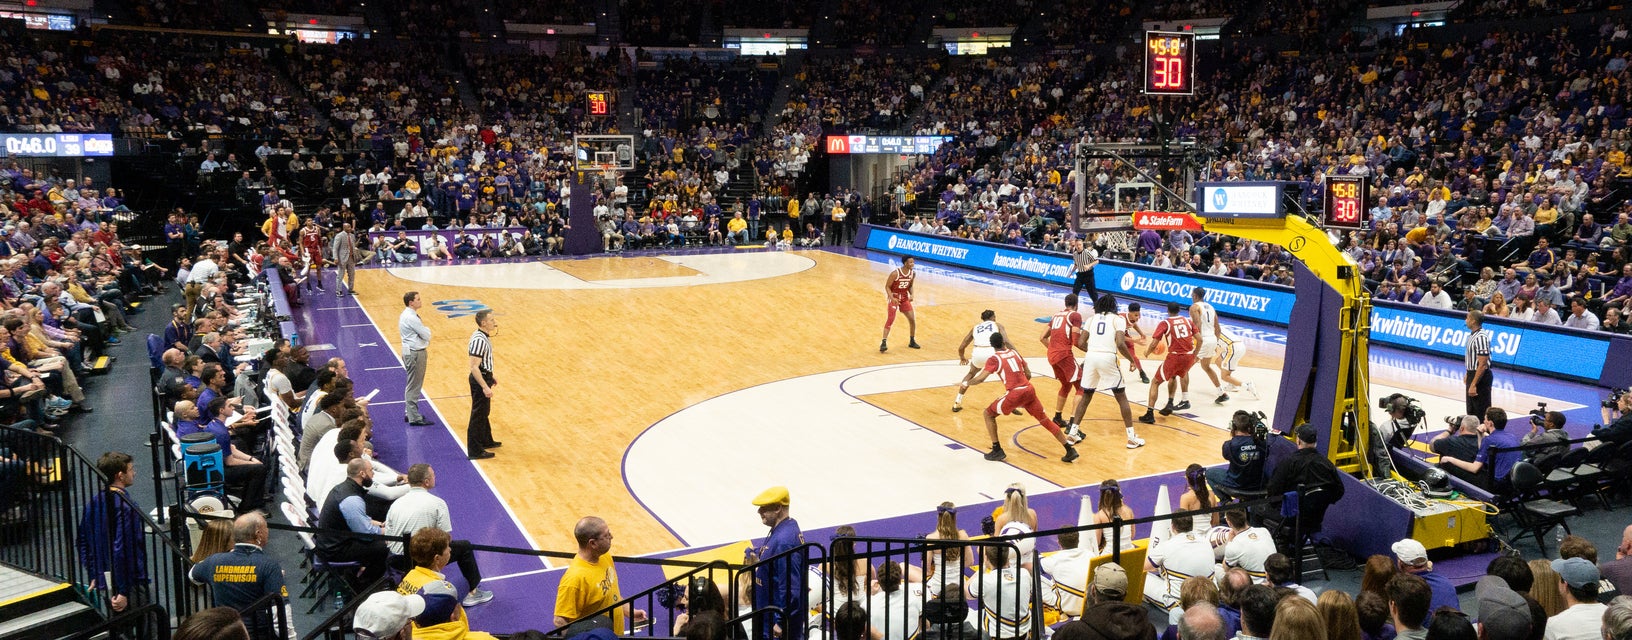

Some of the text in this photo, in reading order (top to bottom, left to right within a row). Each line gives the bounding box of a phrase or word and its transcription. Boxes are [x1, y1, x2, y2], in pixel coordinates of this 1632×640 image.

[1154, 57, 1182, 88] 30
[591, 101, 606, 114] 30
[6, 136, 57, 153] 0:46.0
[65, 144, 80, 155] 39
[1332, 183, 1356, 198] 45.8
[1337, 200, 1356, 219] 30
[896, 238, 969, 259] HANCOCK WHITNEY
[898, 281, 909, 289] 22
[1203, 287, 1271, 312] WHITNEY
[1051, 315, 1064, 330] 10
[1206, 311, 1211, 323] 1
[976, 323, 993, 334] 24
[1096, 321, 1106, 335] 0
[1173, 324, 1189, 339] 13
[1006, 357, 1020, 373] 11
[1240, 444, 1257, 452] CREW
[215, 565, 257, 574] LANDMARK
[213, 573, 257, 582] SUPERVISOR
